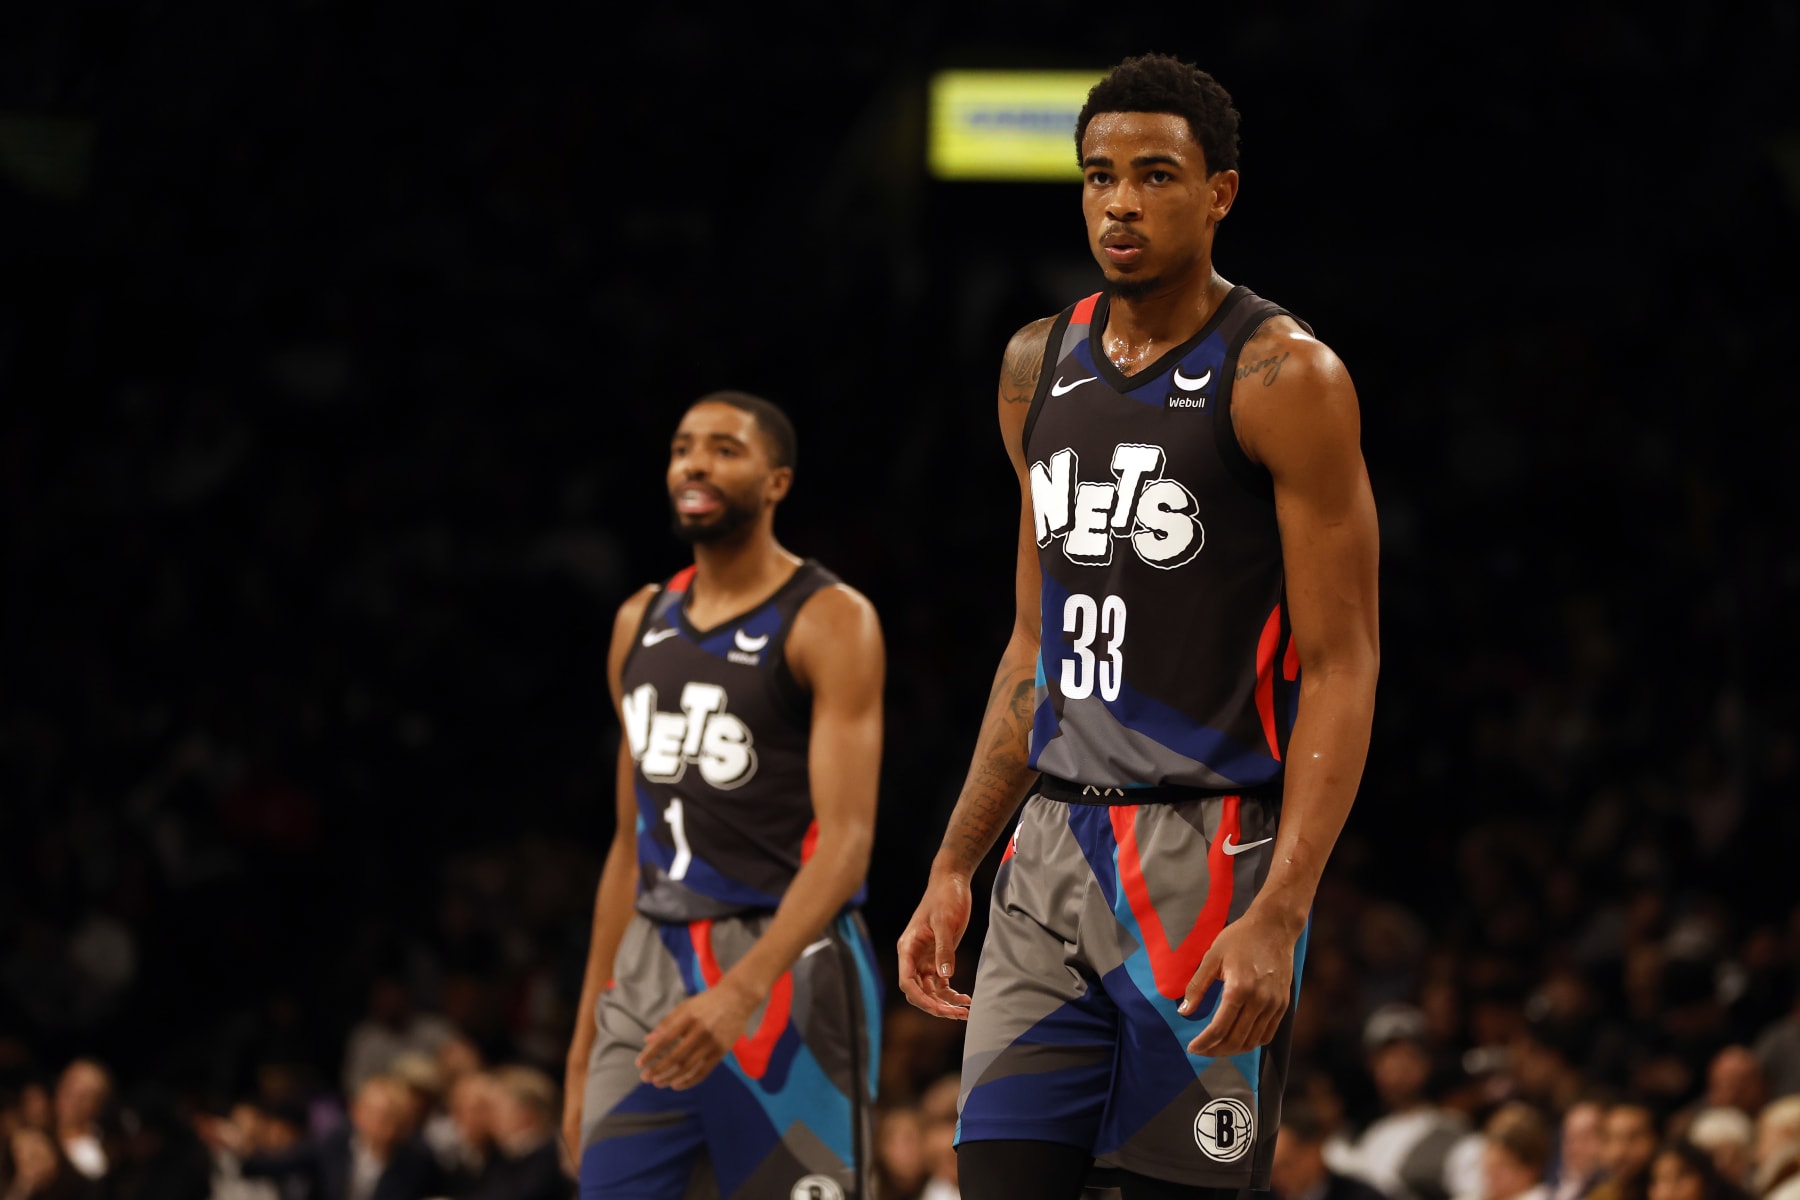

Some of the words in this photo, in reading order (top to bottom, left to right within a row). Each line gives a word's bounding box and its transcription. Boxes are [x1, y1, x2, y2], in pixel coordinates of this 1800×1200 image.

[1169, 397, 1206, 408] Webull
[1030, 443, 1205, 570] NETS
[1060, 593, 1127, 702] 33
[622, 682, 758, 790] NETS
[663, 797, 692, 881] 1
[1215, 1108, 1238, 1150] B
